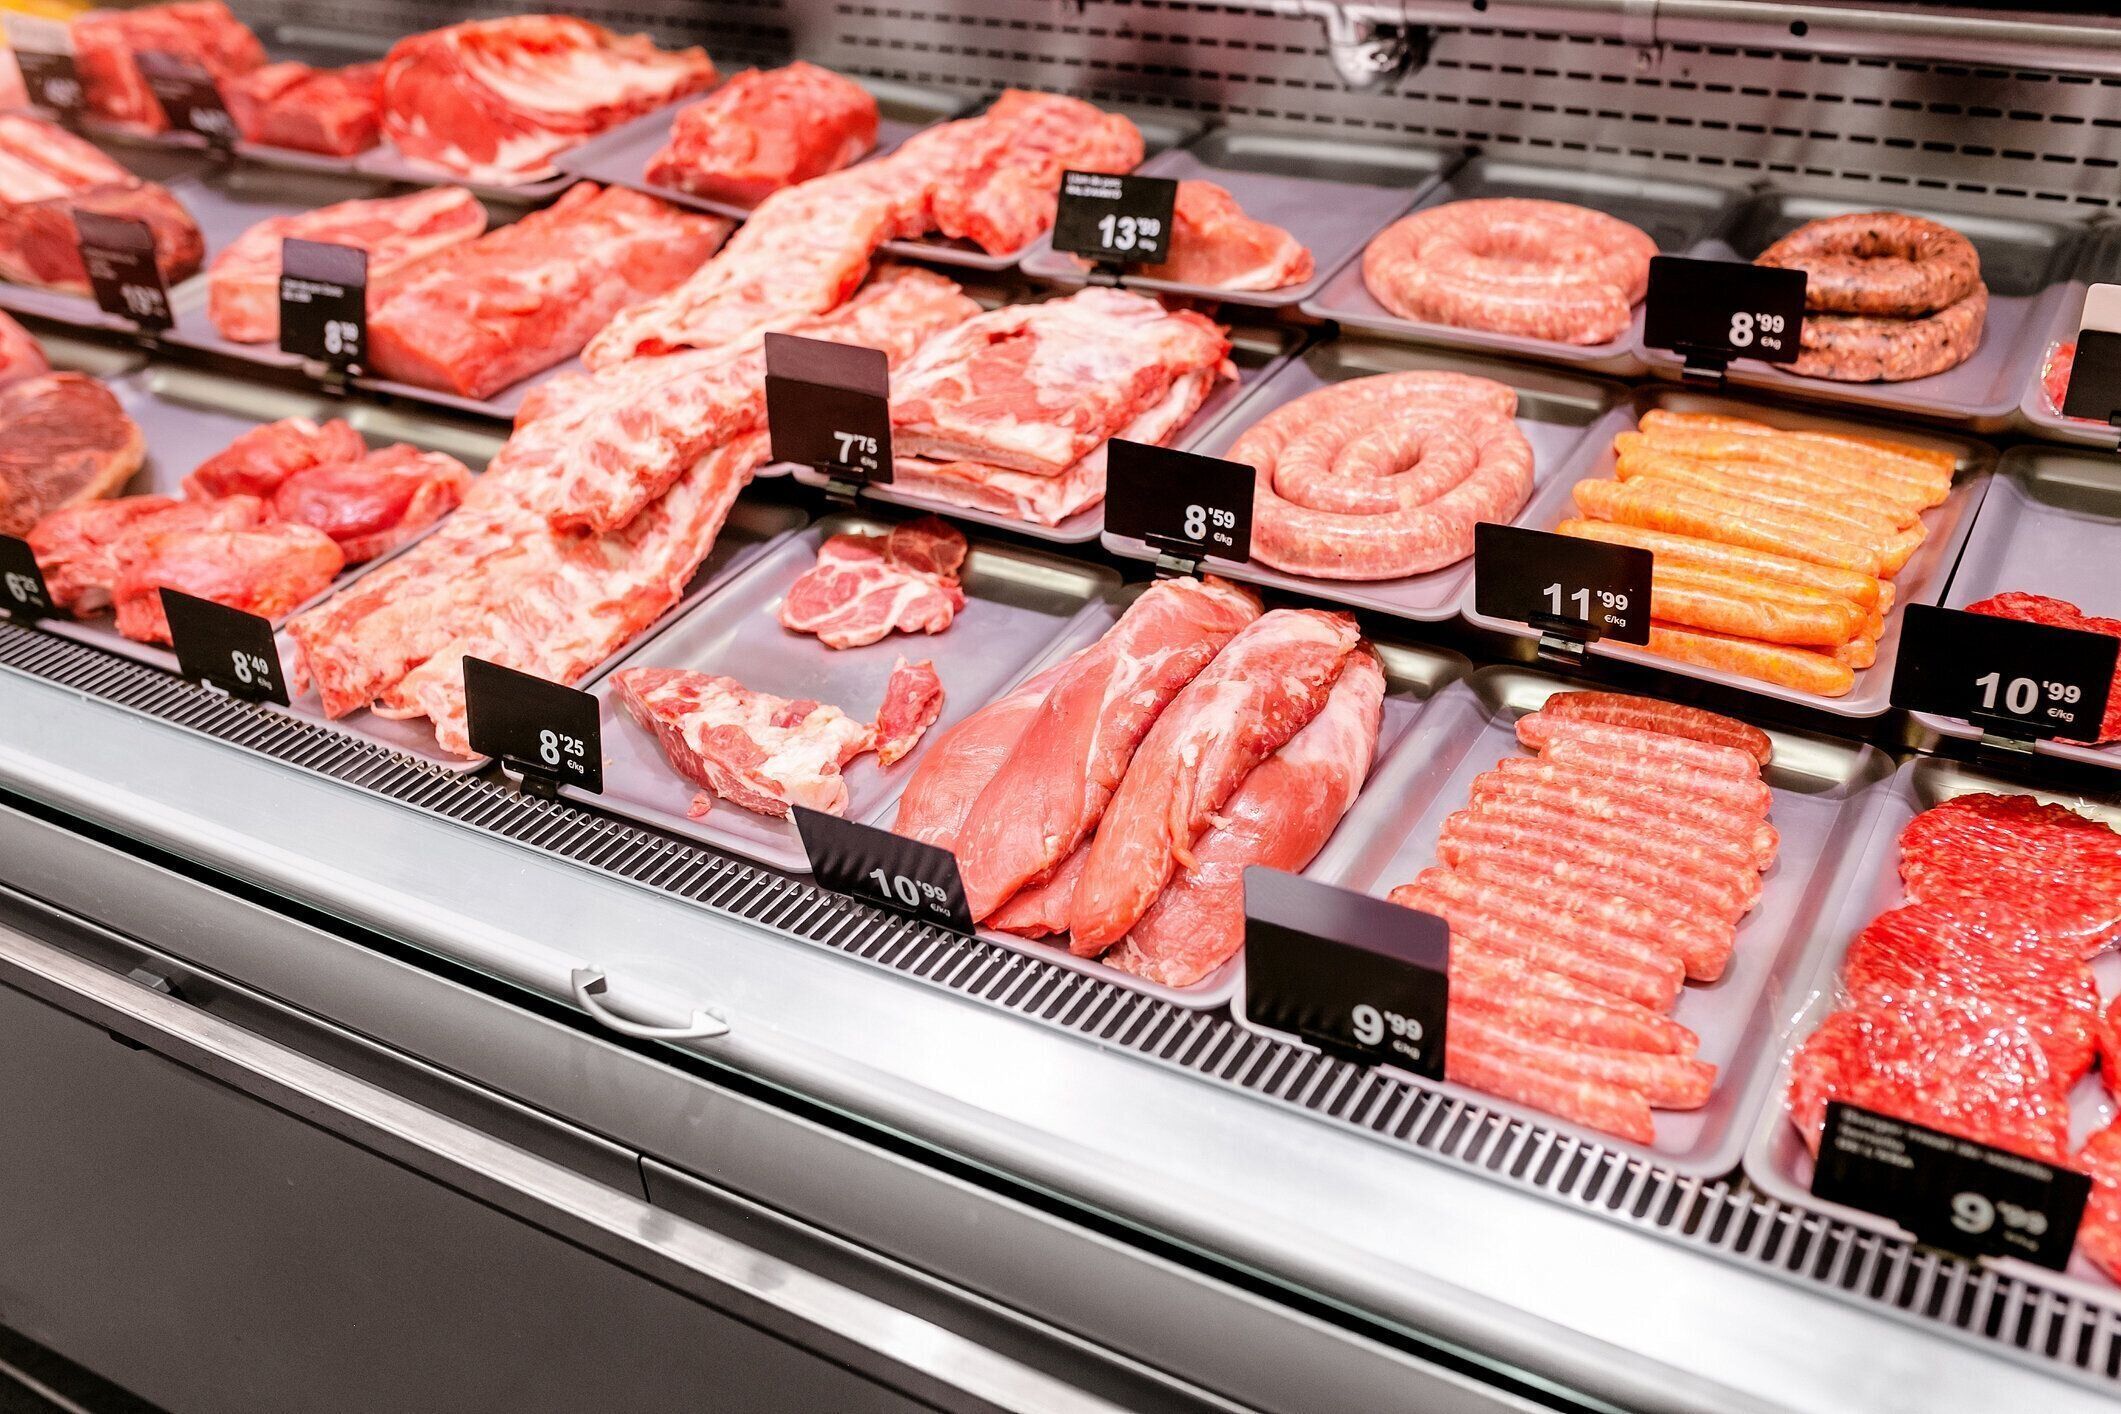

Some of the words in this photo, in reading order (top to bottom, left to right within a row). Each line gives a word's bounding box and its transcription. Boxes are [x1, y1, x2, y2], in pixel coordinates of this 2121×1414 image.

[1728, 311, 1785, 350] 8'99
[833, 430, 878, 465] 7'75
[1183, 504, 1236, 542] 8'59
[1543, 582, 1629, 622] 11'99
[1603, 614, 1626, 628] €/kg
[231, 649, 271, 685] 8'49
[1973, 671, 2082, 716] 10'99
[2046, 707, 2075, 723] €/kg
[539, 729, 585, 767] 8'25
[566, 759, 585, 775] €/kg
[869, 867, 948, 908] 10'99
[1351, 1004, 1423, 1048] 9'99
